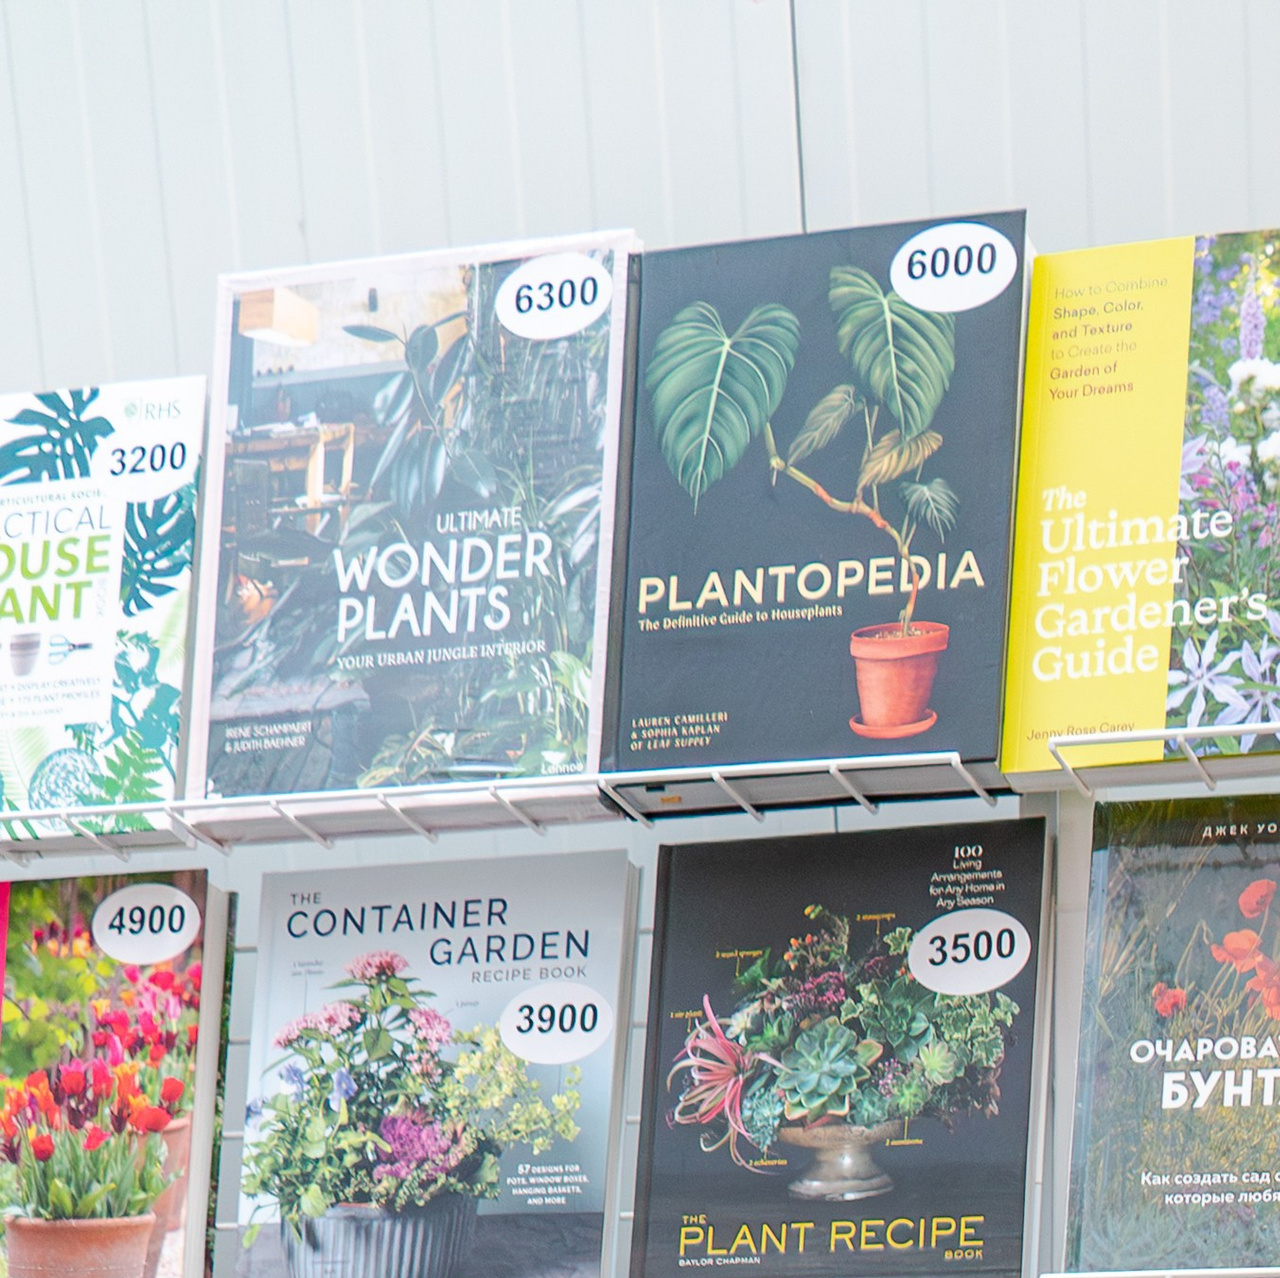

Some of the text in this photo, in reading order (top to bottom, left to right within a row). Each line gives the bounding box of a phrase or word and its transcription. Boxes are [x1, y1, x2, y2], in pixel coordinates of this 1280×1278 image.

[907, 243, 997, 280] 6000
[514, 276, 599, 314] 6300
[110, 442, 187, 477] 3200
[1042, 486, 1087, 511] The
[437, 506, 522, 534] ULTIMATE
[1041, 507, 1233, 555] Ultimate
[333, 533, 554, 594] WONDER
[638, 551, 985, 614] PLANTOPEDIA
[1037, 554, 1189, 597] Flower
[337, 585, 511, 643] PLANTS
[638, 604, 843, 632] The Definitive Guide to Houseplants
[1035, 588, 1268, 639] Gardener's
[1032, 639, 1159, 683] Guide
[1203, 823, 1249, 838] ДЖЕК
[108, 905, 186, 934] 4900
[286, 898, 509, 938] CONTAINER
[430, 930, 590, 966] GARDEN
[928, 928, 1016, 966] 3500
[516, 1004, 598, 1034] 3900
[678, 1216, 985, 1256] PLANT RECIPE
